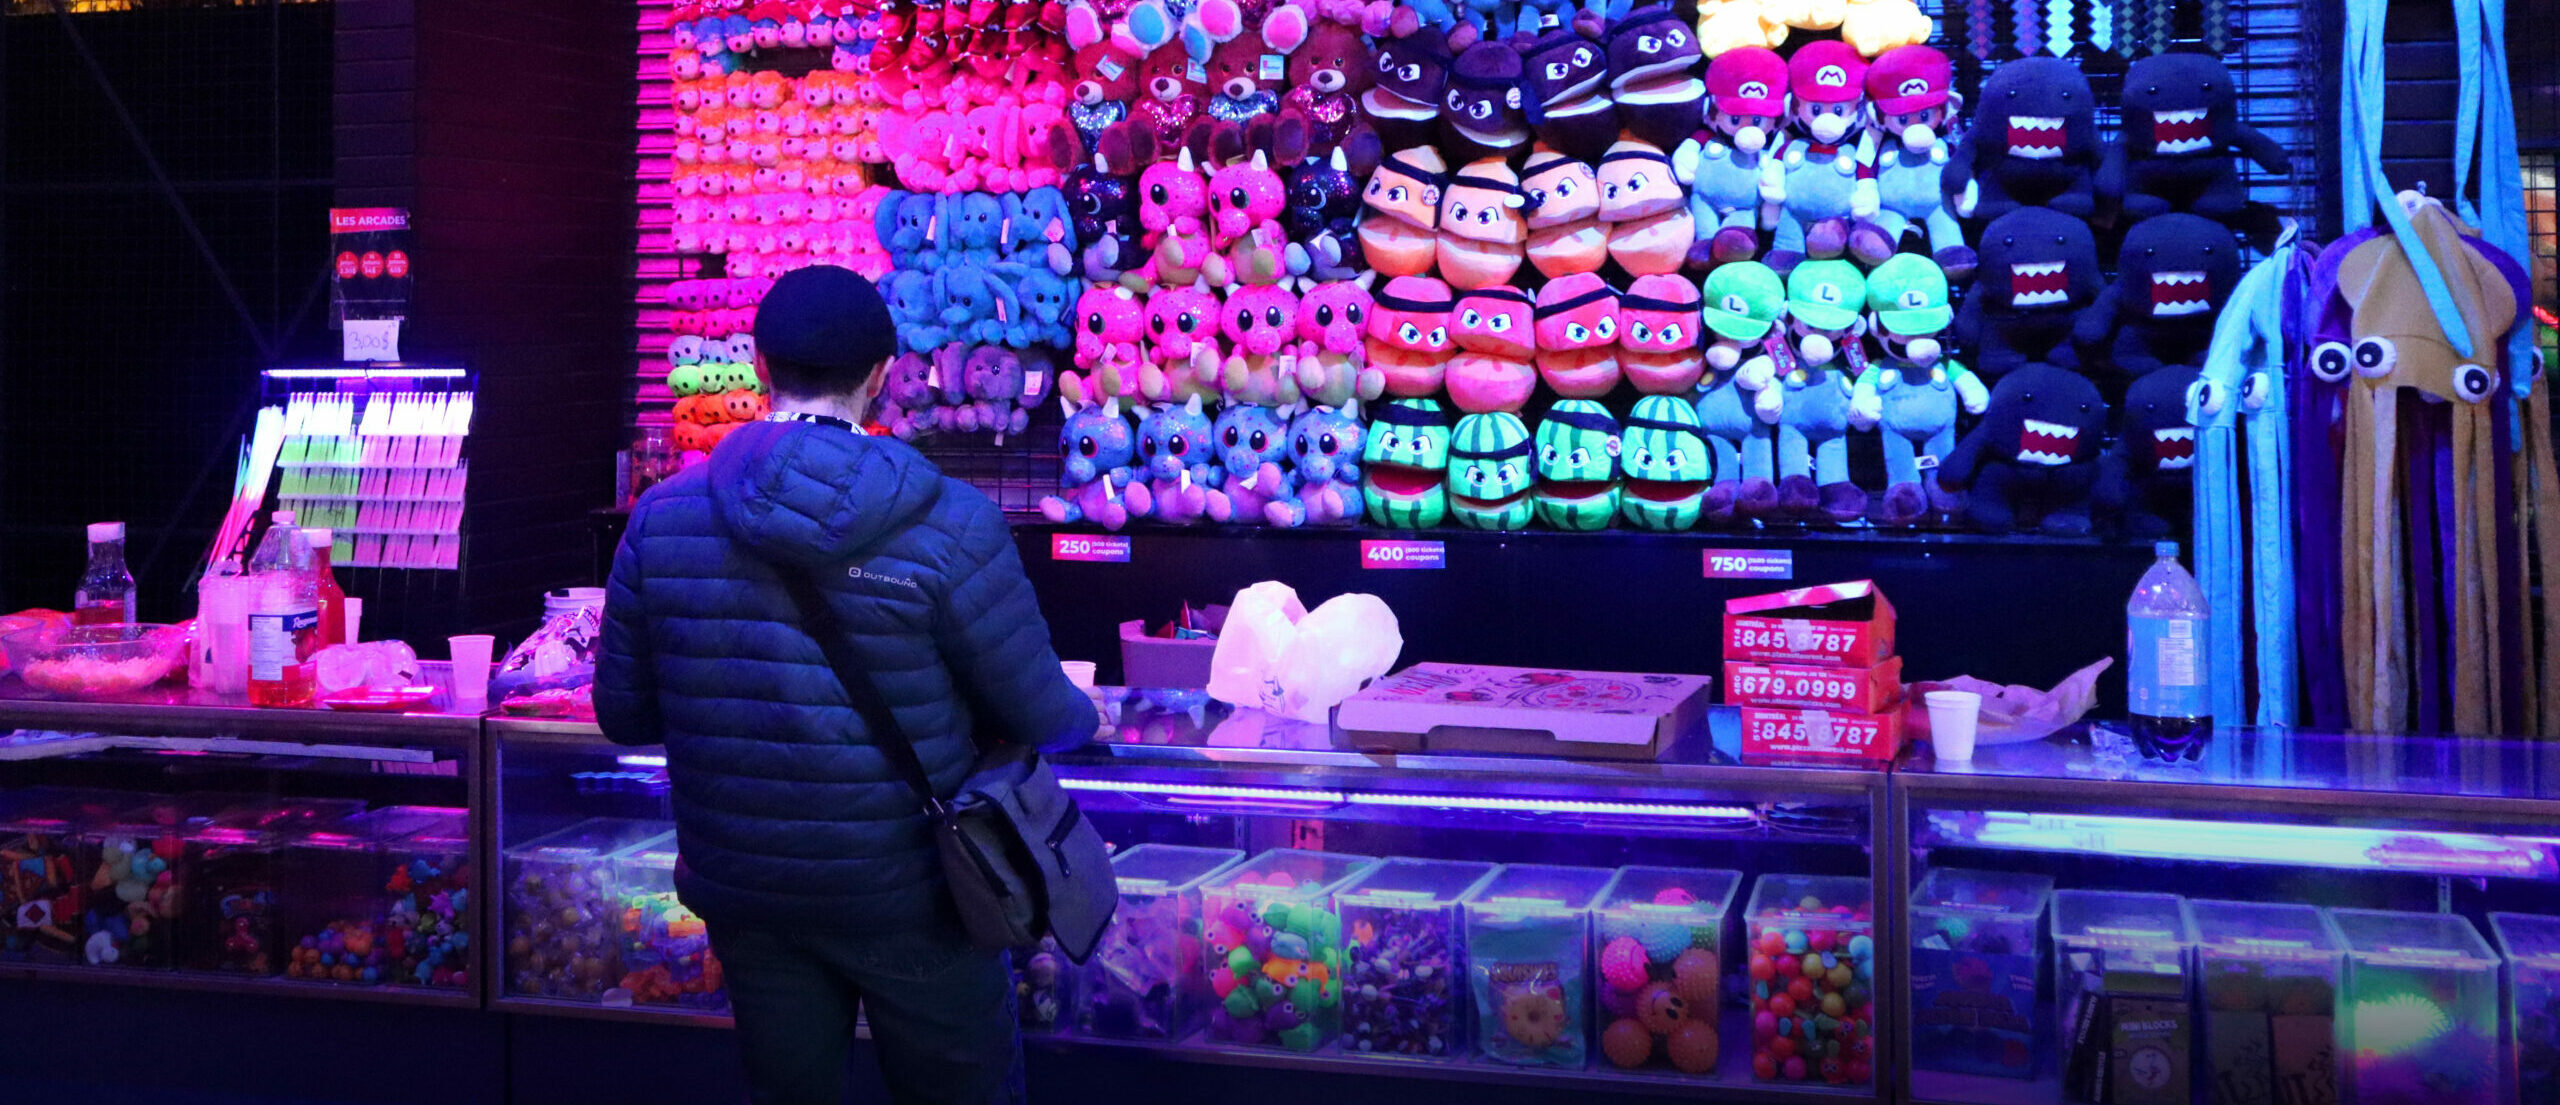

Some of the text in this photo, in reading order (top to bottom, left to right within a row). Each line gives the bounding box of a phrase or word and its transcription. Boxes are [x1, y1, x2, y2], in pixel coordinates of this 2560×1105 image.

[1820, 70, 1842, 83] M
[1742, 86, 1765, 96] M
[1902, 82, 1925, 94] M
[336, 215, 406, 226] LES ARCADES
[1822, 286, 1834, 302] L
[1908, 293, 1921, 307] L
[1729, 297, 1742, 313] L
[1059, 540, 1091, 554] 250
[1092, 548, 1124, 556] coupons
[1367, 546, 1404, 561] 400
[1405, 554, 1440, 562] coupons
[1710, 556, 1747, 572] 750
[1748, 565, 1785, 573] coupons
[863, 572, 918, 588] OUTBOUND
[1743, 676, 1857, 700] 679.0999
